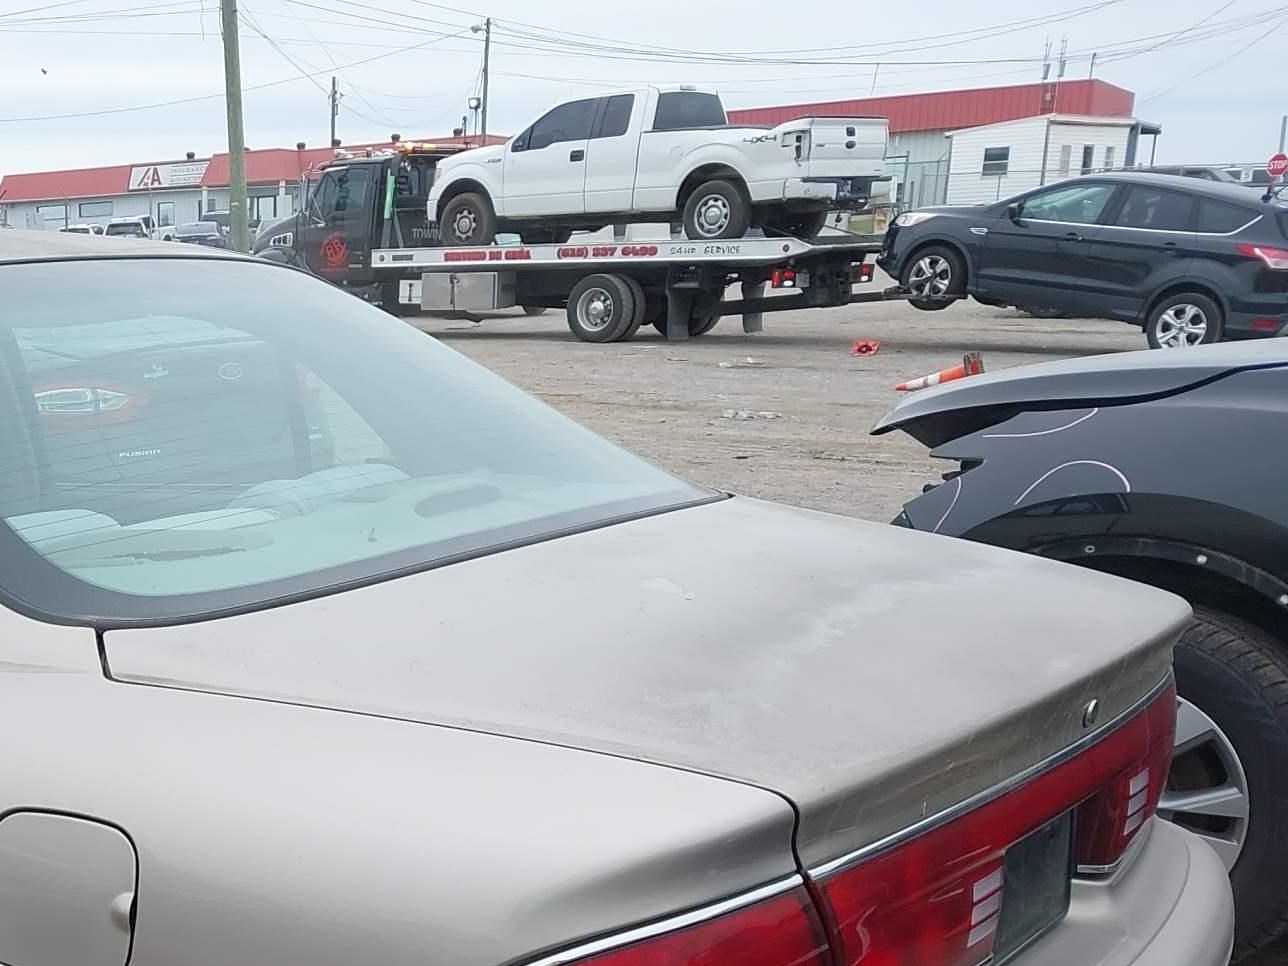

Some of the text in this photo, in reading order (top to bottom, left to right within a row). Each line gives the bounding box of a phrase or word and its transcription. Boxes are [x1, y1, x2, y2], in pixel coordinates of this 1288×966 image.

[1269, 159, 1287, 170] STOP
[411, 227, 442, 240] TOWIN
[703, 245, 741, 255] SERVICE
[119, 448, 161, 458] FUSION
